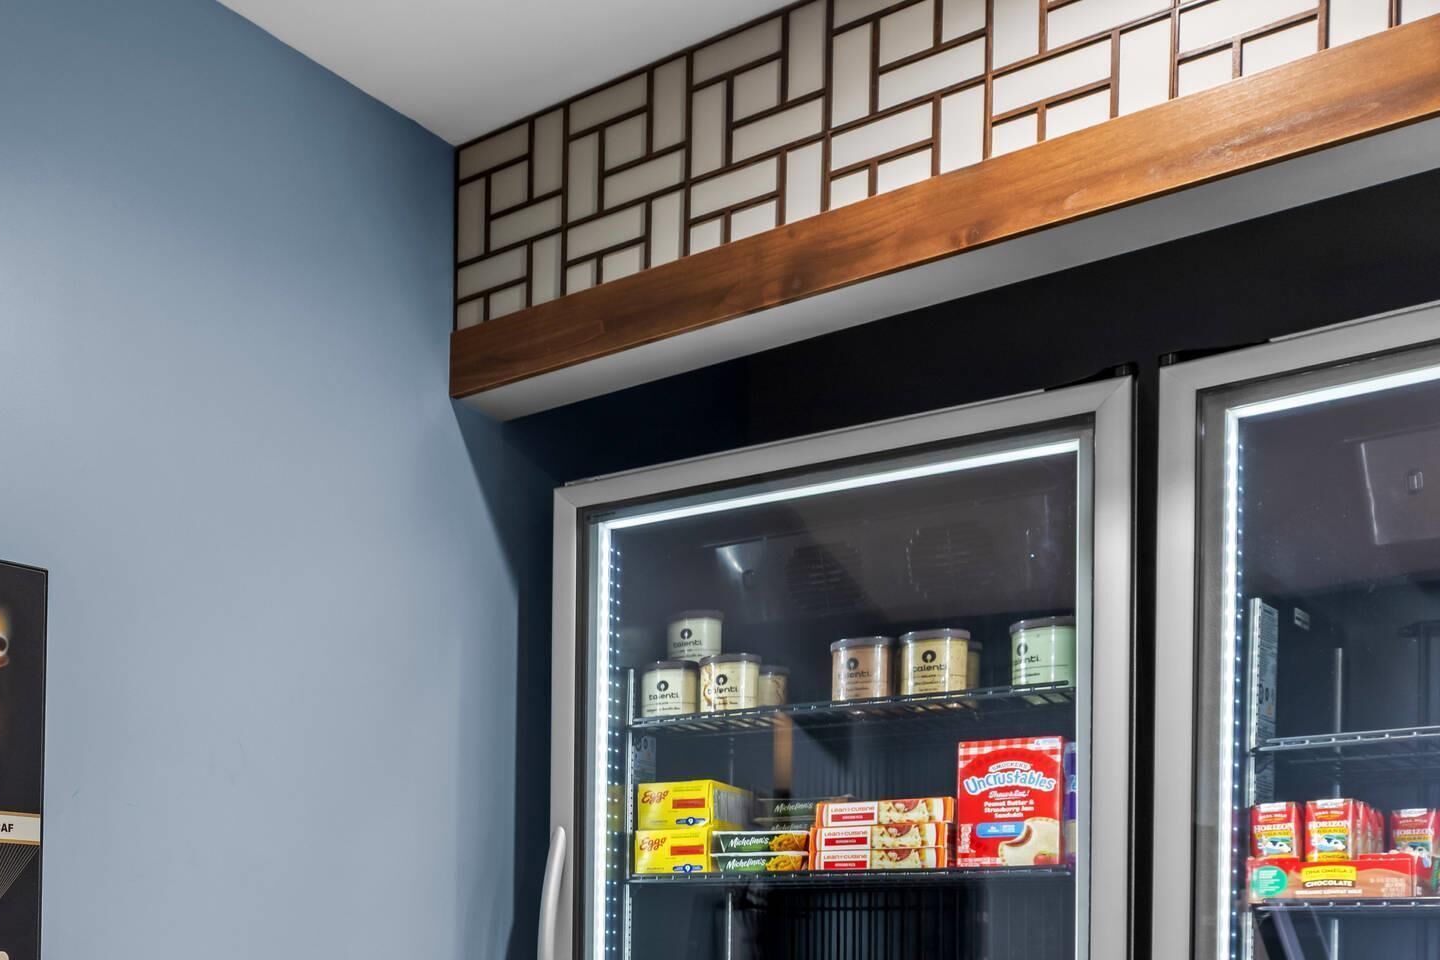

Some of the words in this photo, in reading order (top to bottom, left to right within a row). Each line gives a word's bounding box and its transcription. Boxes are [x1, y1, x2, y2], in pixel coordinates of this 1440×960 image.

[964, 769, 1056, 794] Uncrustables
[641, 790, 670, 805] Eggo
[639, 837, 667, 851] Eggo
[1305, 880, 1353, 888] CHOCOLATE
